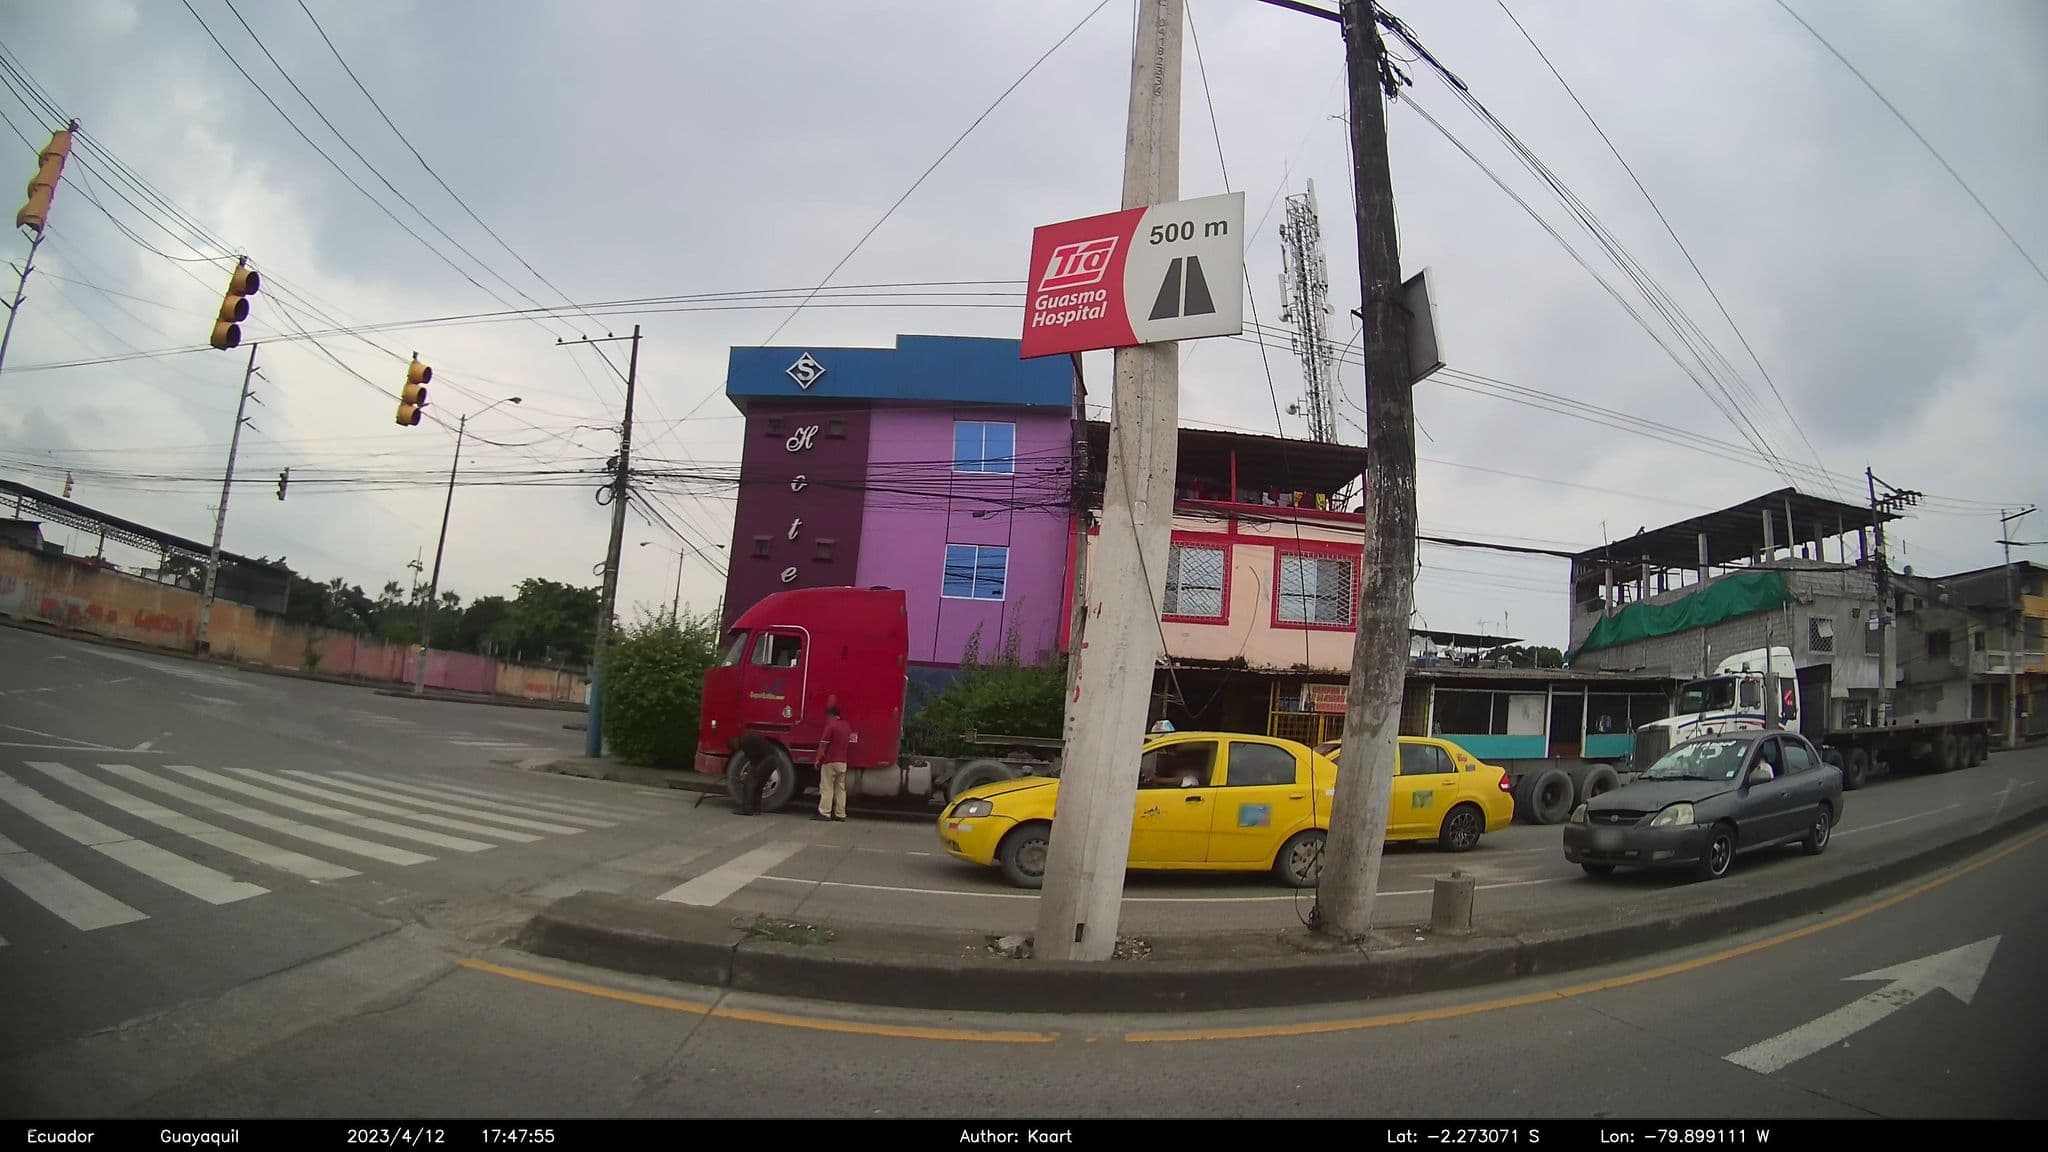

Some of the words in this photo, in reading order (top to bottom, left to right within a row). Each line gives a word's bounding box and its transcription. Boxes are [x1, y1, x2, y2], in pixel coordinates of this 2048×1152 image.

[1149, 220, 1195, 245] 500
[1204, 220, 1228, 238] m
[1035, 289, 1107, 311] Guasmo
[1031, 301, 1108, 328] Hospital
[797, 358, 816, 382] S
